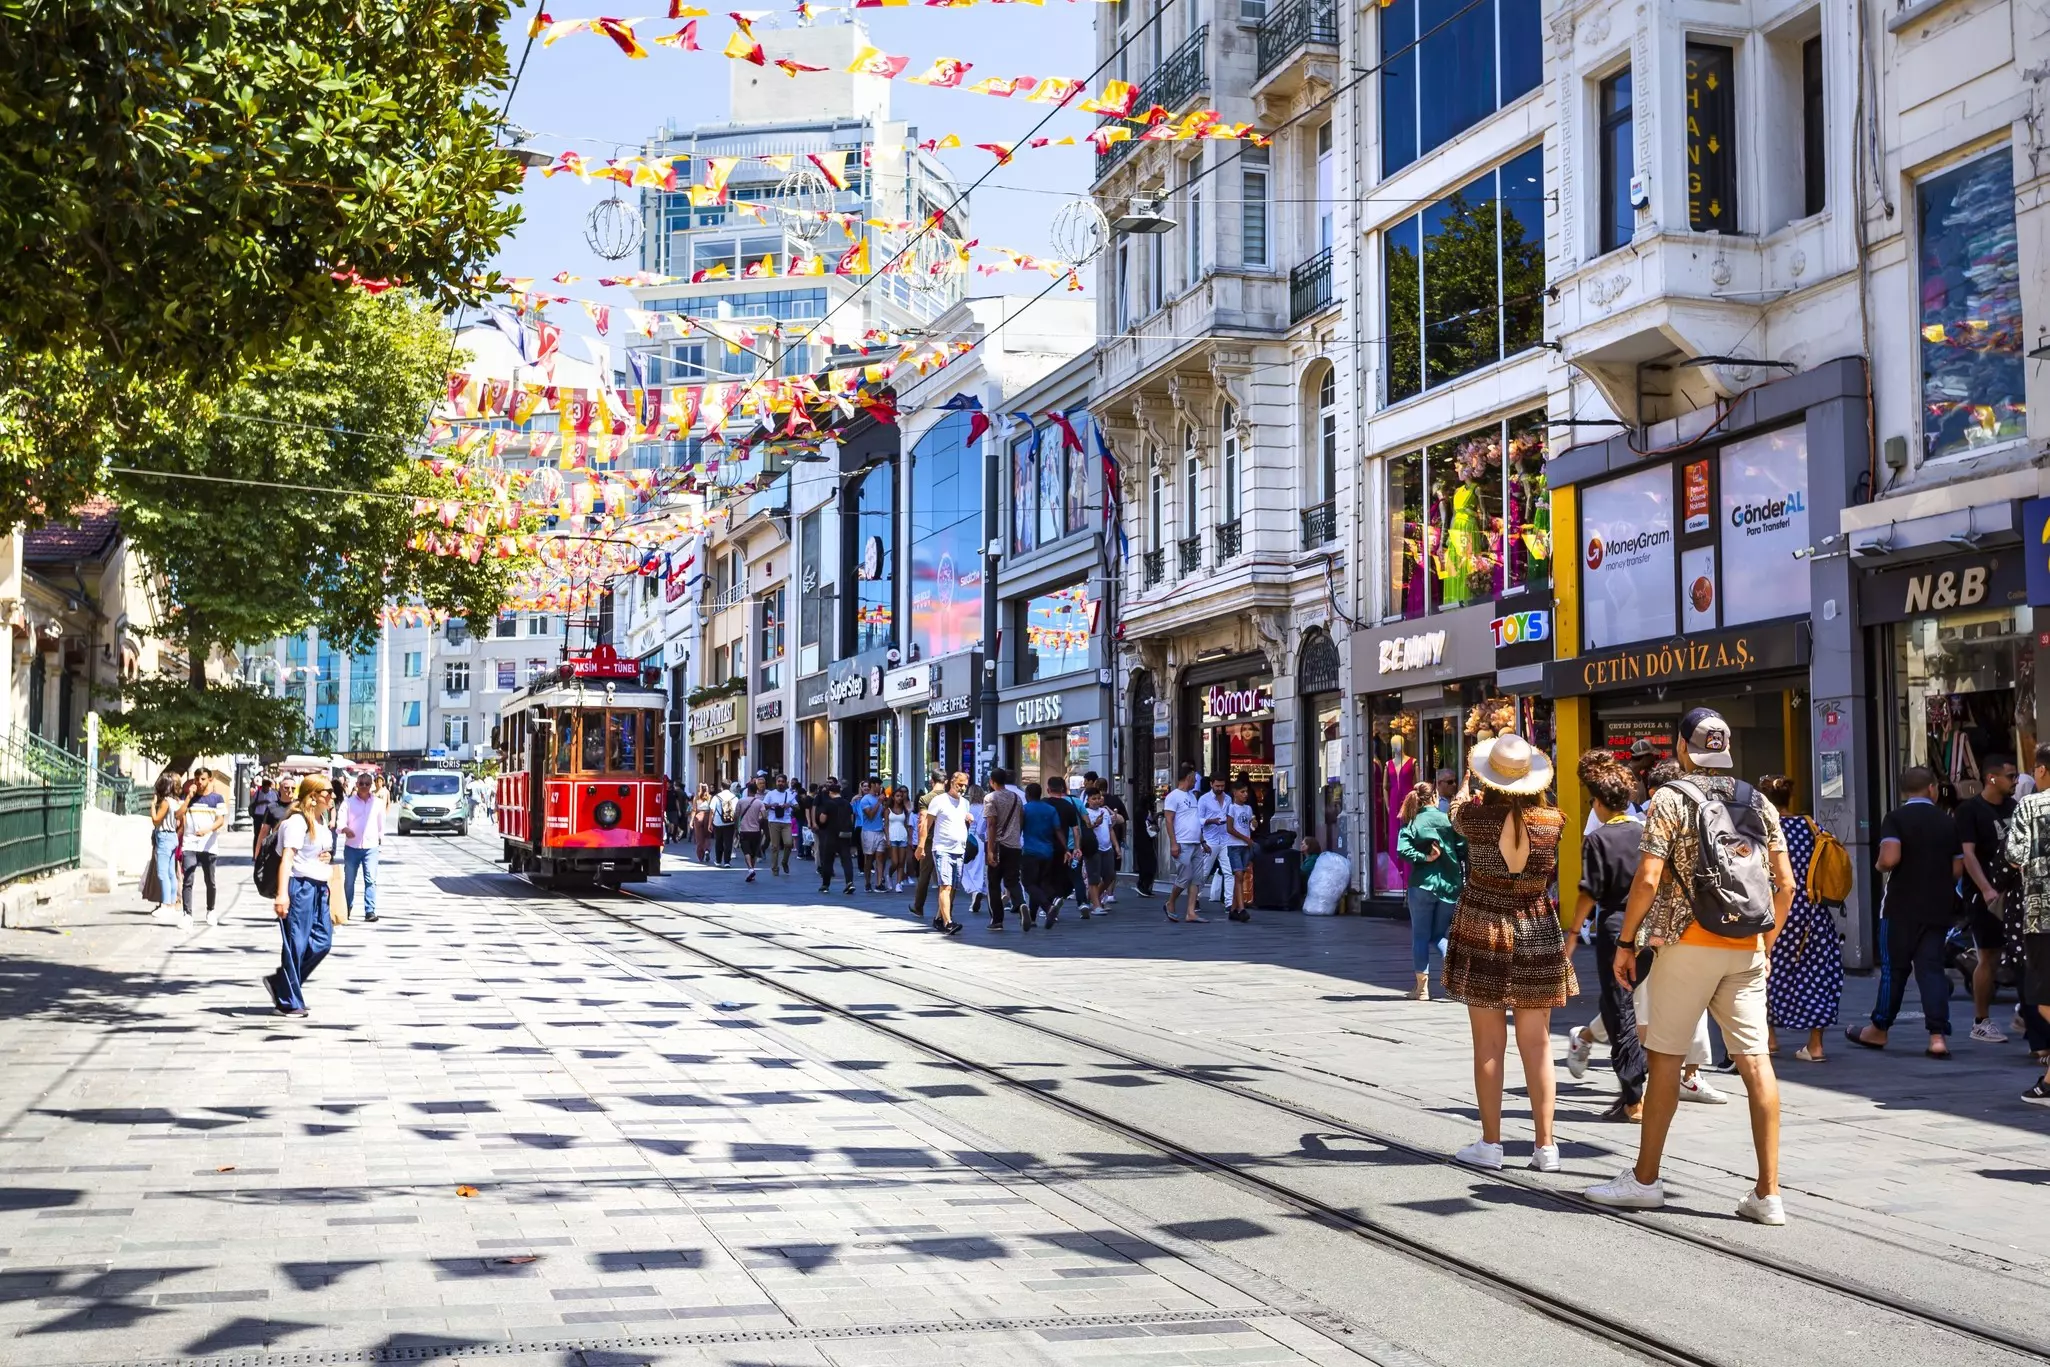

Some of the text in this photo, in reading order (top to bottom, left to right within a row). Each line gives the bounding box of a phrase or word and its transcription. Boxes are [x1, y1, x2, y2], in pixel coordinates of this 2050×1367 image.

[1685, 59, 1701, 222] CHANGE
[1732, 491, 1804, 528] GönderAL
[1747, 517, 1790, 536] Para Transferi
[1605, 530, 1672, 557] MoneyGram
[1606, 553, 1650, 571] money transfer
[1905, 567, 1986, 613] N&B
[1490, 611, 1549, 648] TOYS
[602, 646, 607, 658] 1
[613, 661, 636, 673] TÜNEL
[1584, 638, 1755, 690] ÇETİN DÖVİZ A.Ş.
[830, 675, 863, 704] SuperStep
[1208, 685, 1257, 716] flormar
[928, 699, 949, 717] CHANGE
[949, 695, 969, 713] OFFICE
[1015, 694, 1062, 726] GUESS
